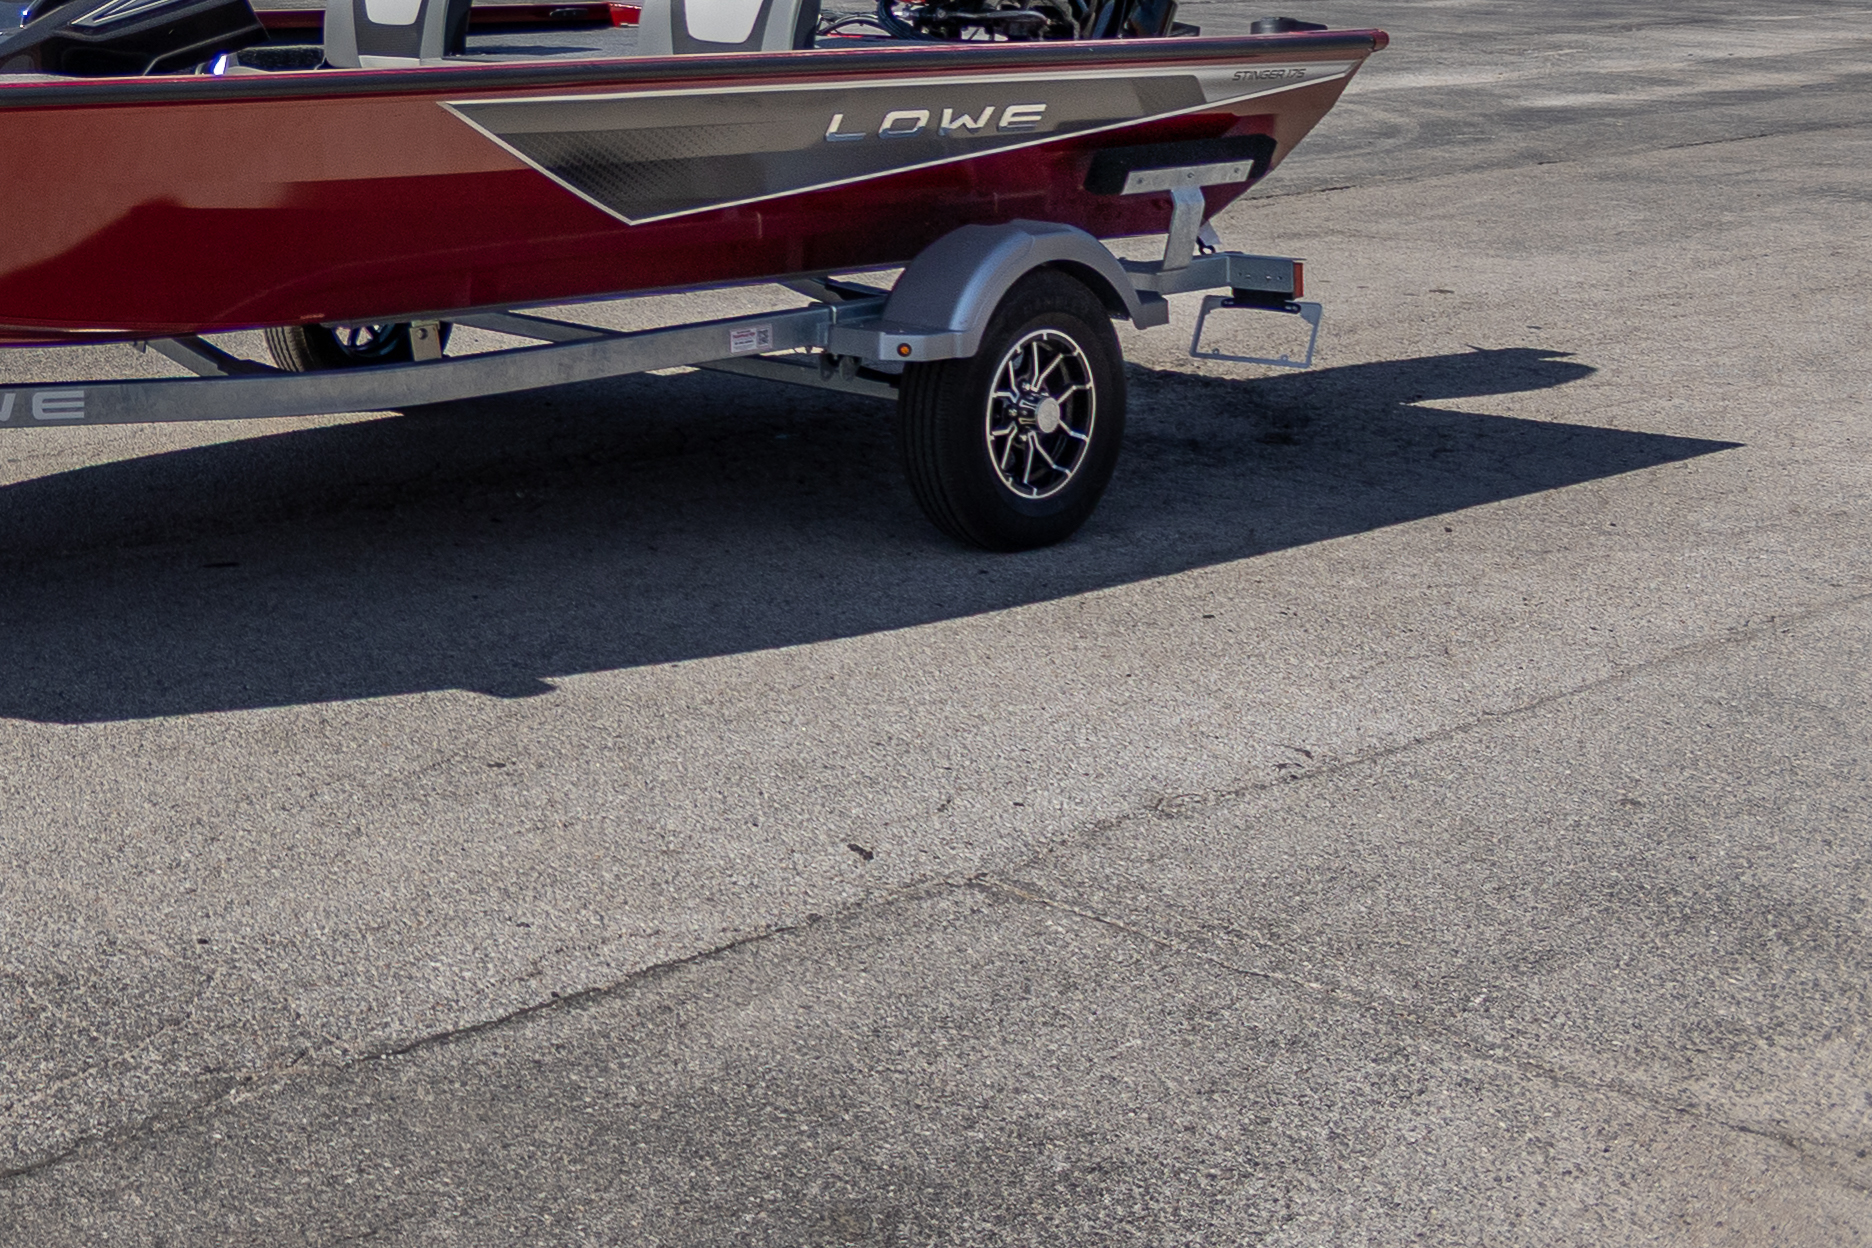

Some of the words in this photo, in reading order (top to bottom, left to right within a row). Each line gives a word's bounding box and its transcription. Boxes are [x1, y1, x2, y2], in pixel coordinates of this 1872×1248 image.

[1232, 69, 1286, 81] STINGER
[1286, 68, 1306, 79] 175
[824, 103, 1047, 142] LOWE
